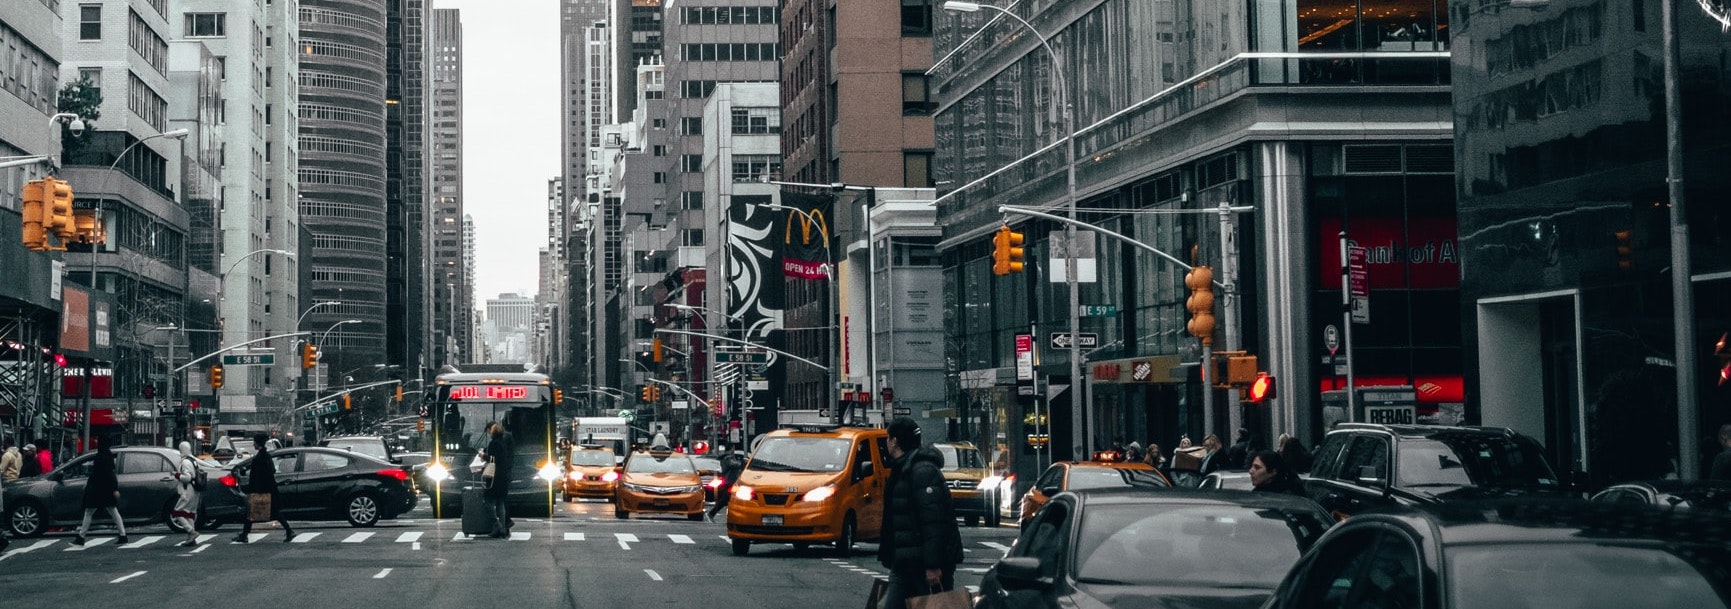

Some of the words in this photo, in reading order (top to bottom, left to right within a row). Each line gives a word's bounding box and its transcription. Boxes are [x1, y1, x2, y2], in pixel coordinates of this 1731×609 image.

[1409, 242, 1434, 264] of
[784, 262, 804, 273] OPEN
[805, 266, 815, 275] 24
[1087, 306, 1092, 316] E
[1096, 305, 1107, 315] 59
[1079, 336, 1094, 345] WAY
[485, 385, 527, 399] LIMITED
[1369, 408, 1412, 424] REBAG
